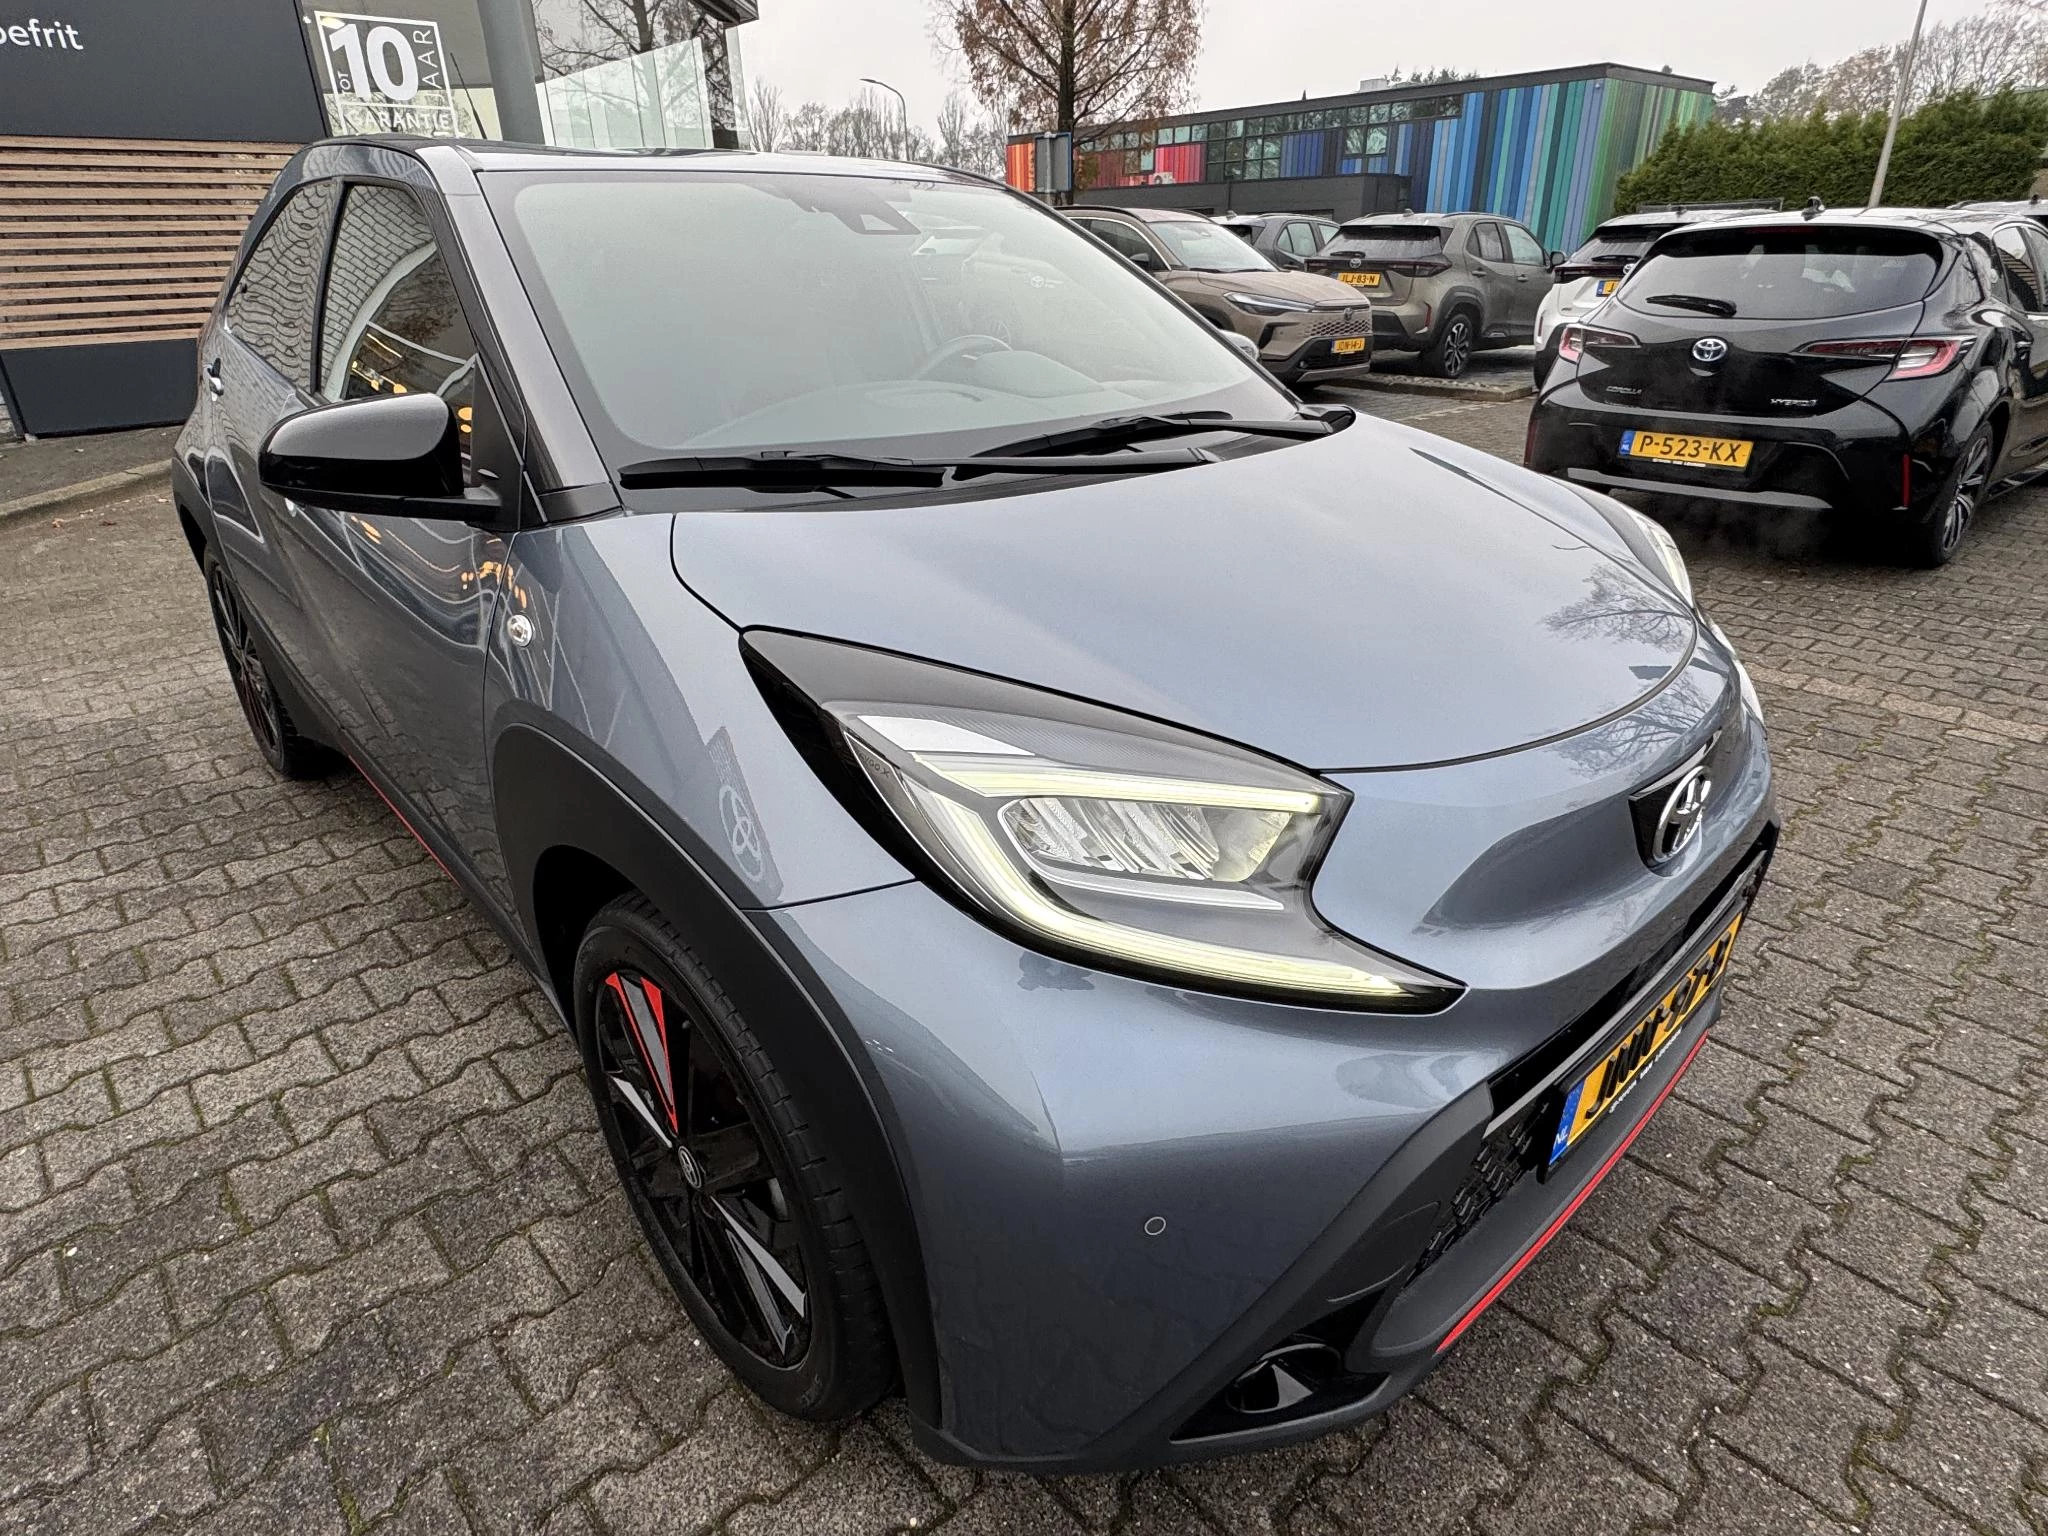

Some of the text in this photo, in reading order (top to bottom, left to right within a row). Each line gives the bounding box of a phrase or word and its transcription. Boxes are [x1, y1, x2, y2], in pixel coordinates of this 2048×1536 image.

[329, 23, 419, 103] 10
[412, 29, 446, 103] JAAR
[337, 71, 351, 95] TOT
[346, 108, 453, 131] GARANTIE
[1639, 435, 1742, 463] P-523-KX
